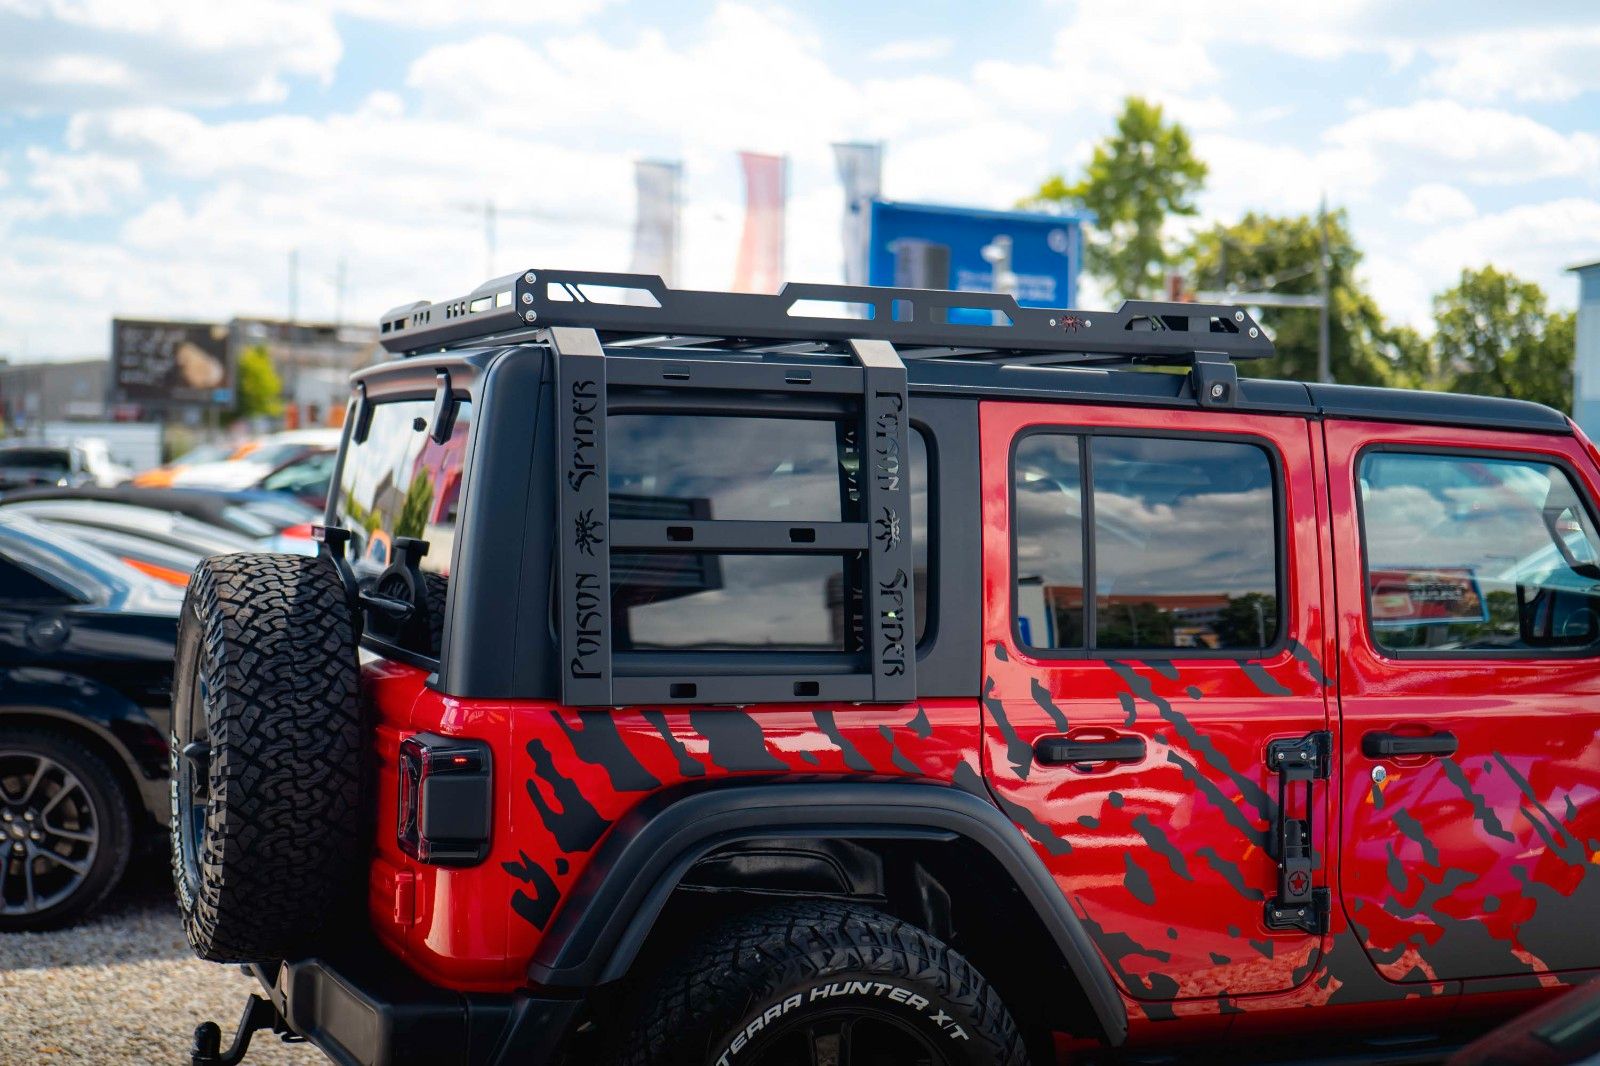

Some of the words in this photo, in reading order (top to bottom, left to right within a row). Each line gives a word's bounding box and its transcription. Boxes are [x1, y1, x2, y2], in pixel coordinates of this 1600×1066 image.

[715, 994, 802, 1066] TERRA
[809, 981, 929, 1011] HUNTER
[929, 1008, 970, 1041] X/T
